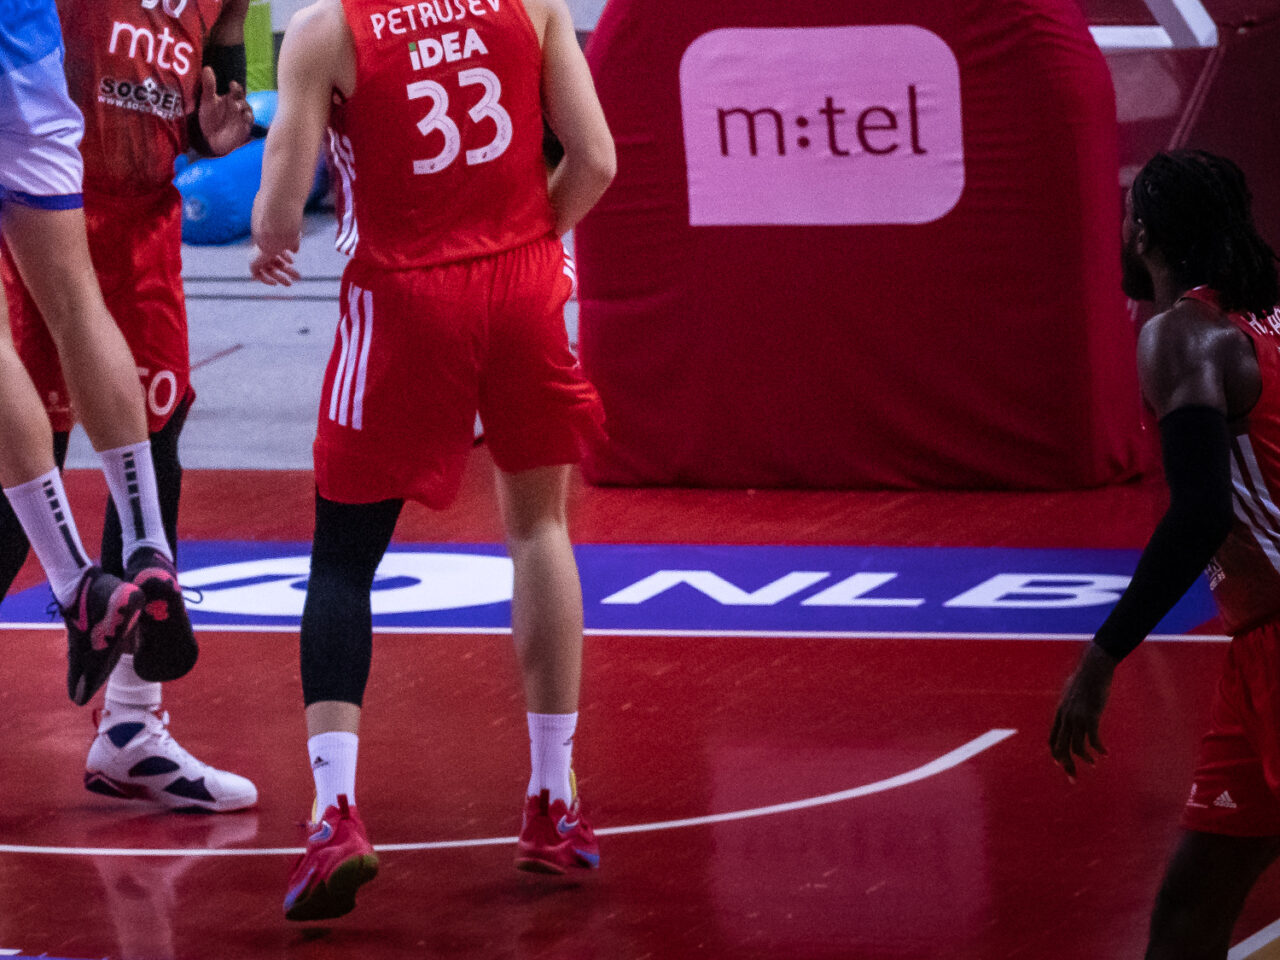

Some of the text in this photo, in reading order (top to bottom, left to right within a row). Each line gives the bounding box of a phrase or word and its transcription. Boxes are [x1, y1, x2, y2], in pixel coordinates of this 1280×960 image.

[109, 21, 195, 76] mts
[406, 67, 513, 175] 33
[717, 84, 928, 157] m:tel
[600, 569, 1132, 608] NLB
